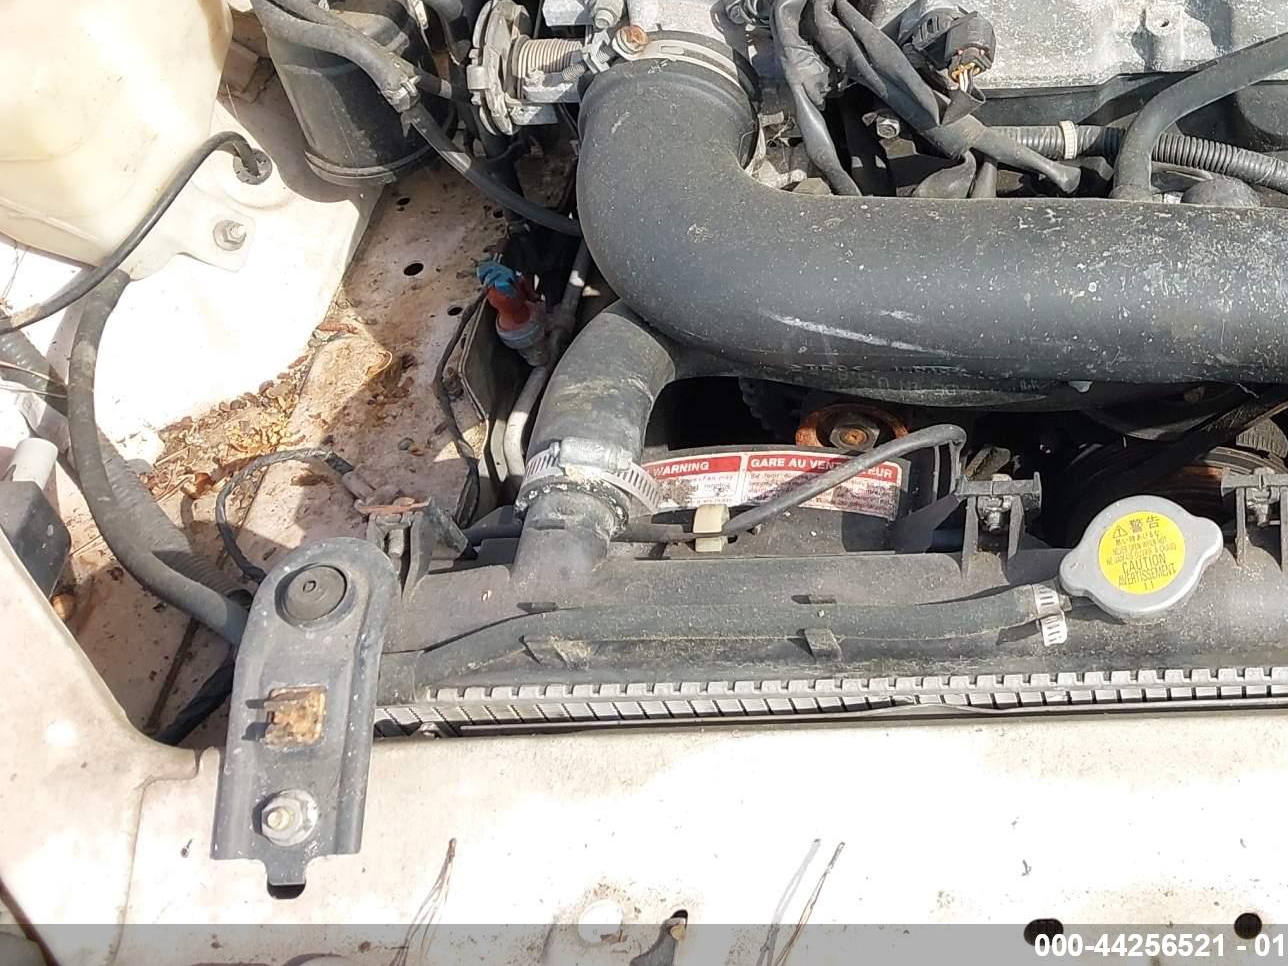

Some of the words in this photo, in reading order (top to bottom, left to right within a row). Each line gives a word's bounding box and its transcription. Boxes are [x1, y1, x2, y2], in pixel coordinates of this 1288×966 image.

[654, 461, 710, 476] WARNING
[750, 458, 784, 468] GARE
[788, 458, 806, 468] AU
[1122, 554, 1166, 574] CAUTION
[1118, 563, 1176, 586] AVERTISSEMENT
